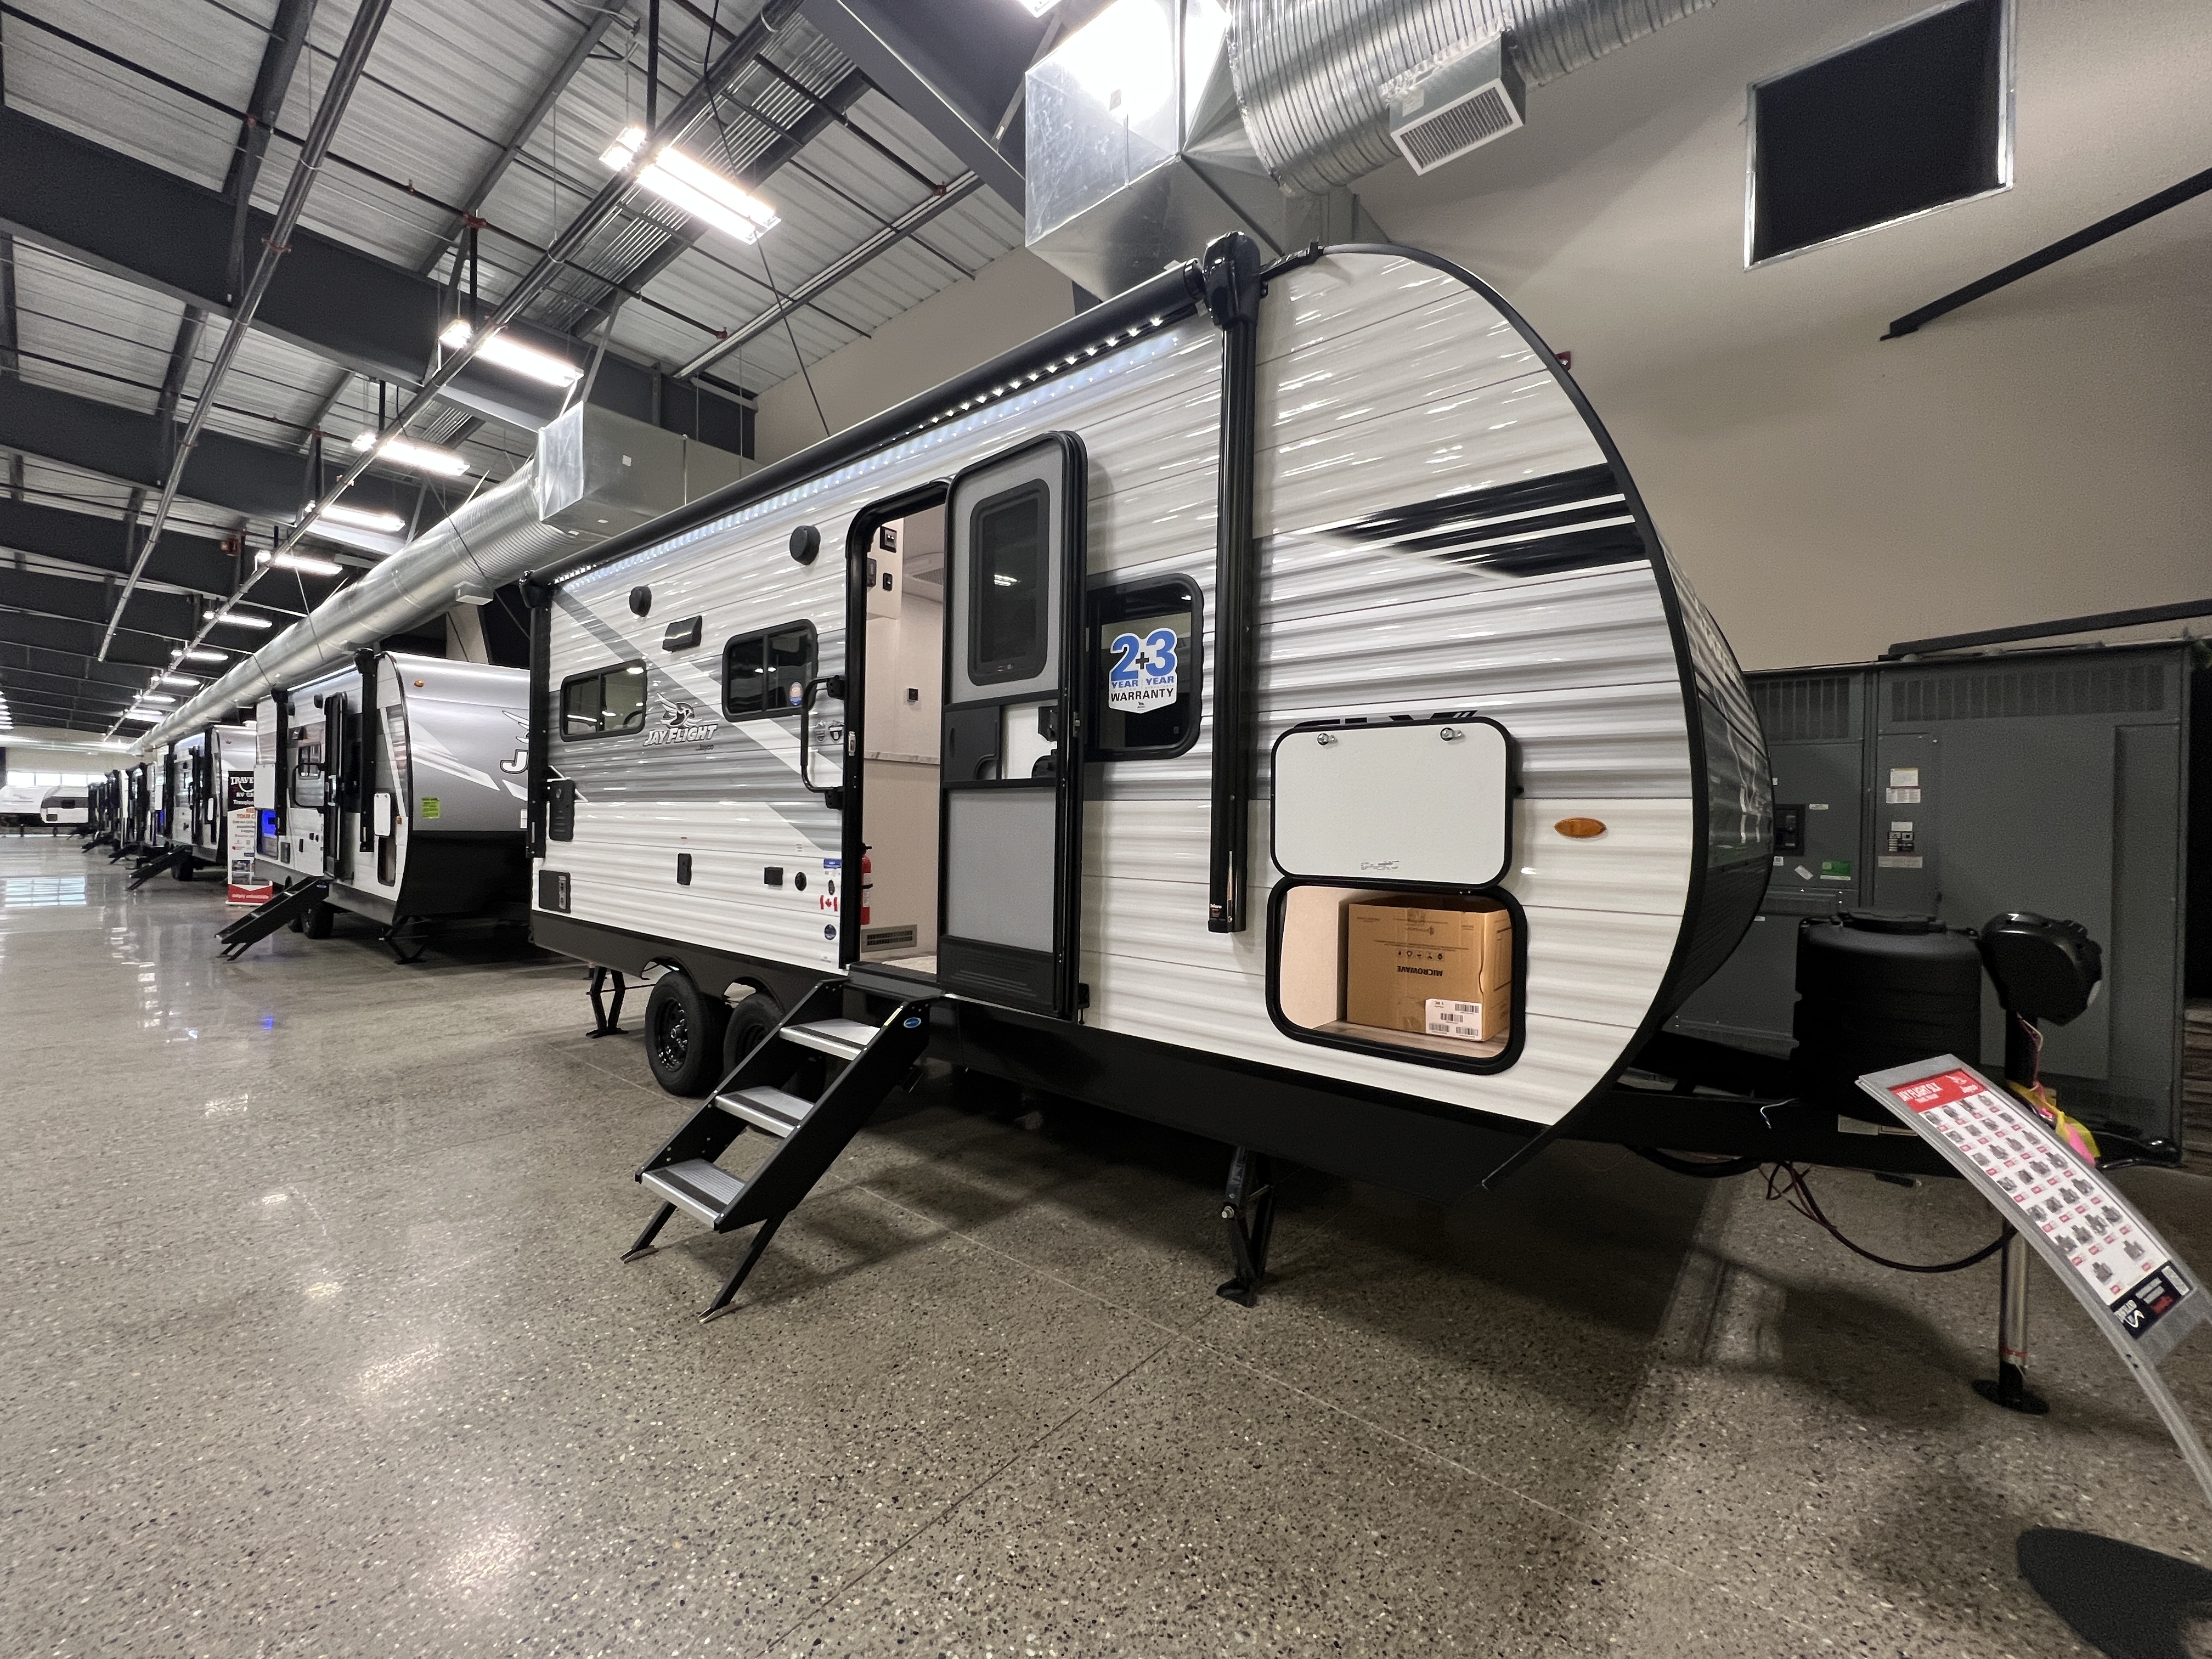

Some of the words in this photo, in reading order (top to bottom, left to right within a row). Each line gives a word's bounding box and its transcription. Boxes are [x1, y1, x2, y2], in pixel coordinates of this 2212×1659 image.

[1111, 680, 1138, 689] YEAR
[1146, 676, 1174, 685] YEAR
[1111, 688, 1173, 702] WARRANTY
[642, 729, 668, 747] JAY
[666, 724, 718, 744] FLIGHT
[1397, 966, 1443, 977] MICROWAVE
